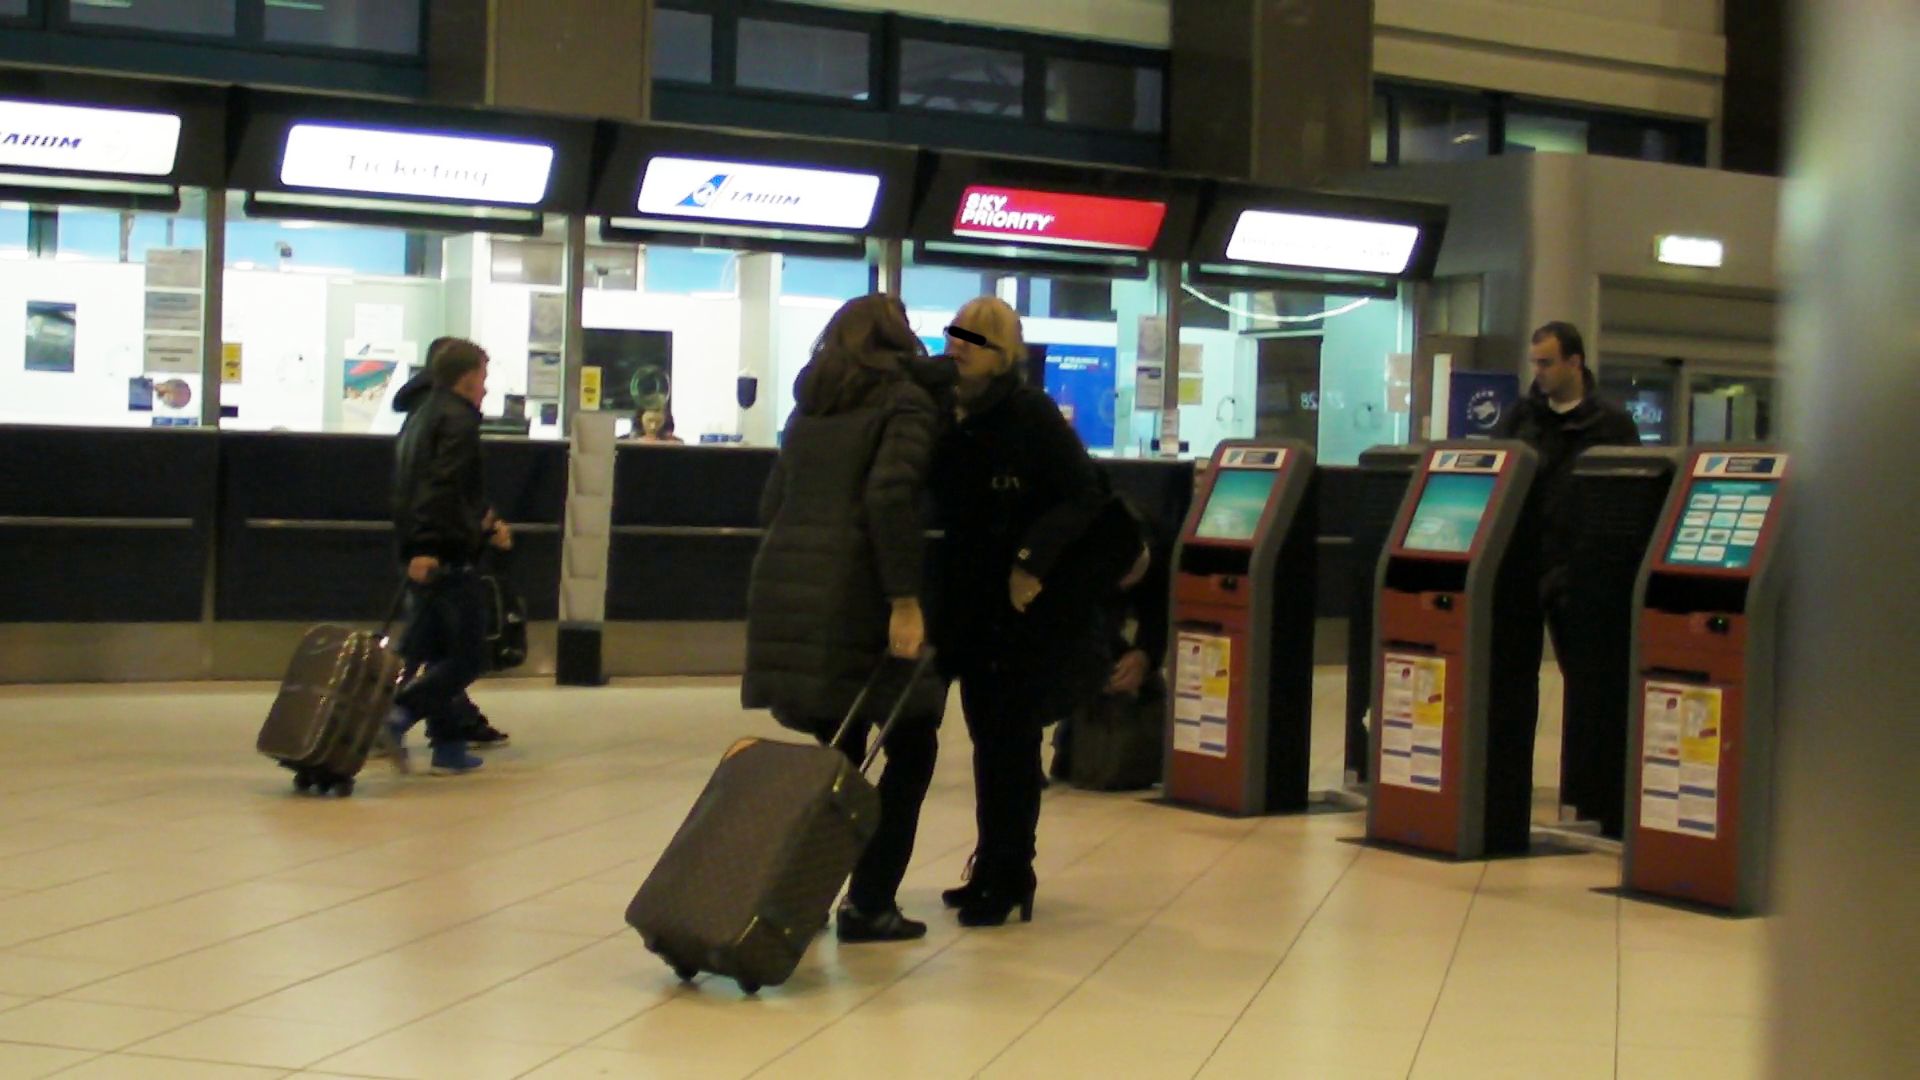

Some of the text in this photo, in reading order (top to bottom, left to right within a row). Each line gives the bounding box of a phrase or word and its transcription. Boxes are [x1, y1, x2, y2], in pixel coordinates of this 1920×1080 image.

[347, 154, 488, 187] Ticketing
[965, 192, 1008, 212] SKY
[960, 208, 1052, 232] PRIORITY
